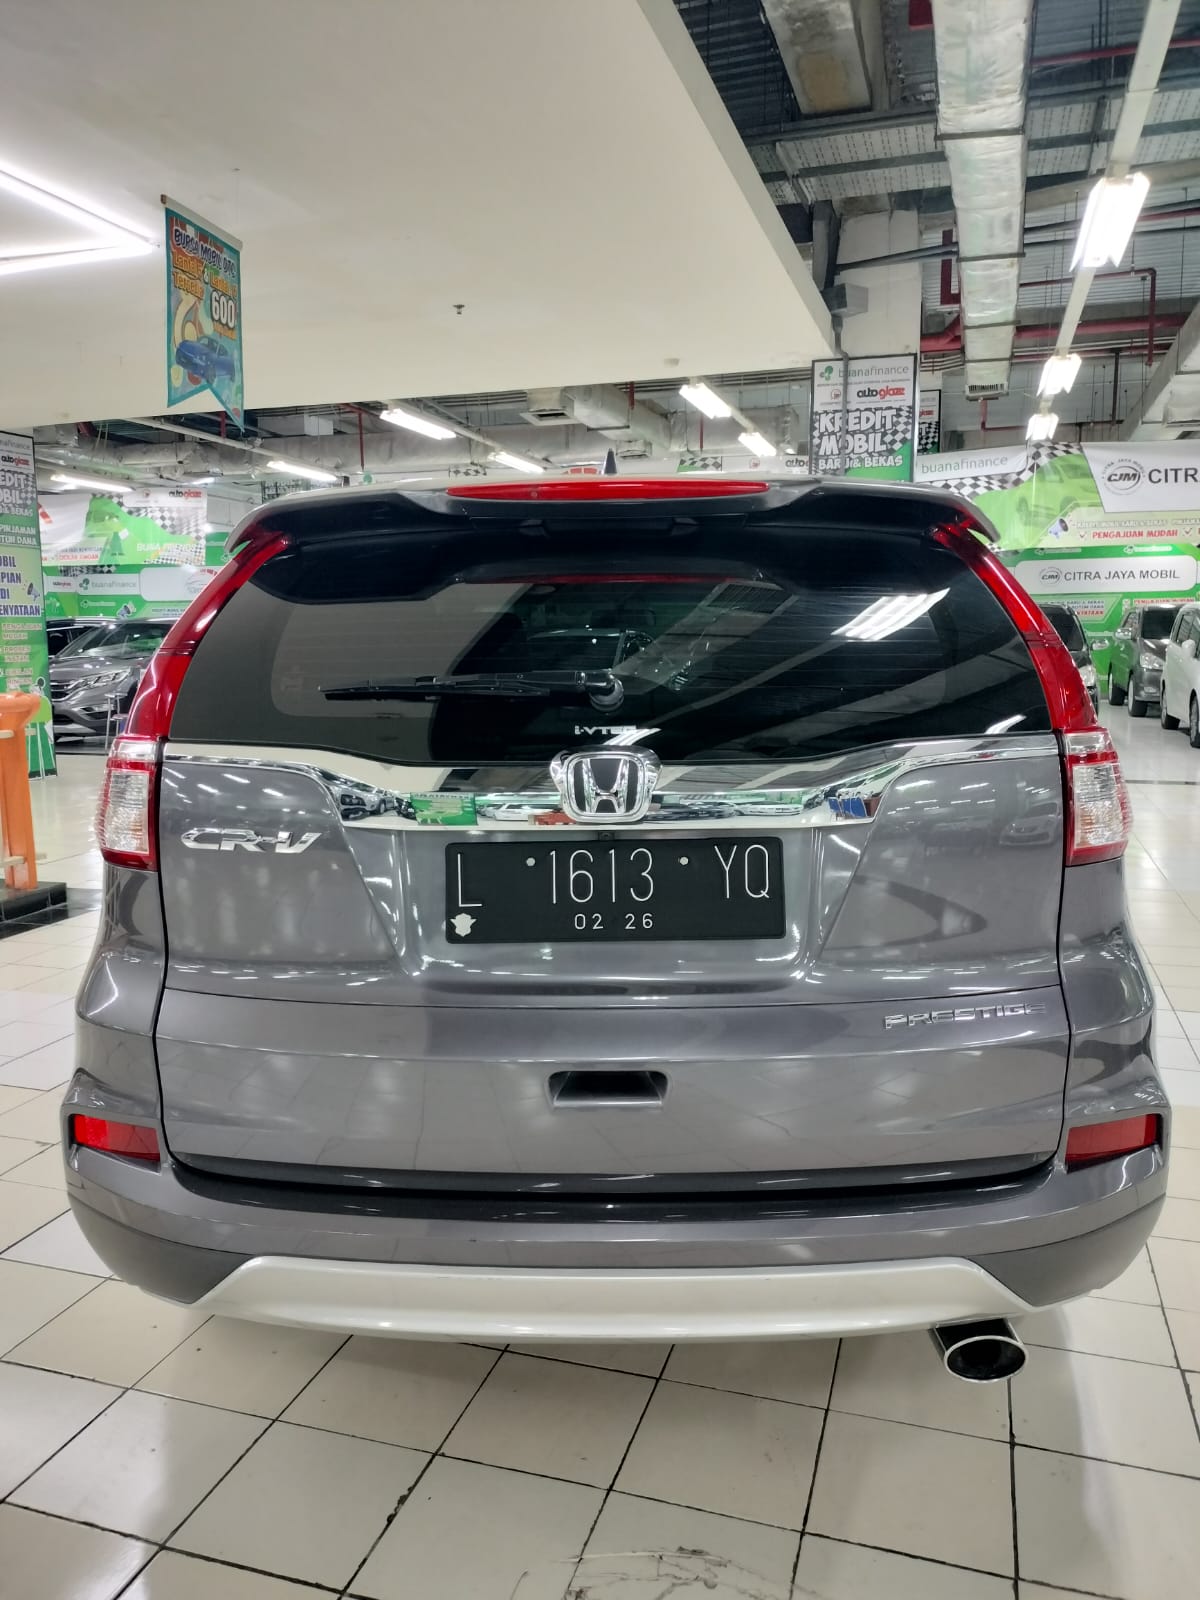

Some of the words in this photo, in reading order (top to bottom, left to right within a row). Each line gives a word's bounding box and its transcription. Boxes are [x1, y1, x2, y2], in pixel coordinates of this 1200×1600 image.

[174, 228, 200, 256] BURSA
[200, 243, 222, 271] MOBIL
[211, 290, 235, 329] 600
[820, 409, 897, 433] KREDIT
[819, 432, 887, 456] MOBIL
[864, 455, 903, 468] BEKAS
[921, 455, 1008, 474] buanafinance
[1107, 472, 1139, 482] CJM
[1092, 531, 1144, 539] PENGAJUAN
[1146, 529, 1178, 538] MUDAH
[1064, 571, 1101, 582] CITRA
[1105, 570, 1136, 581] JAYA
[1139, 569, 1180, 580] MOBIL
[181, 827, 322, 854] CR-V
[457, 853, 483, 907] L
[550, 848, 654, 904] 1613
[714, 844, 769, 900] YQ
[574, 913, 604, 930] 02
[624, 913, 654, 930] 26
[884, 1003, 1047, 1030] PRESTIGE
